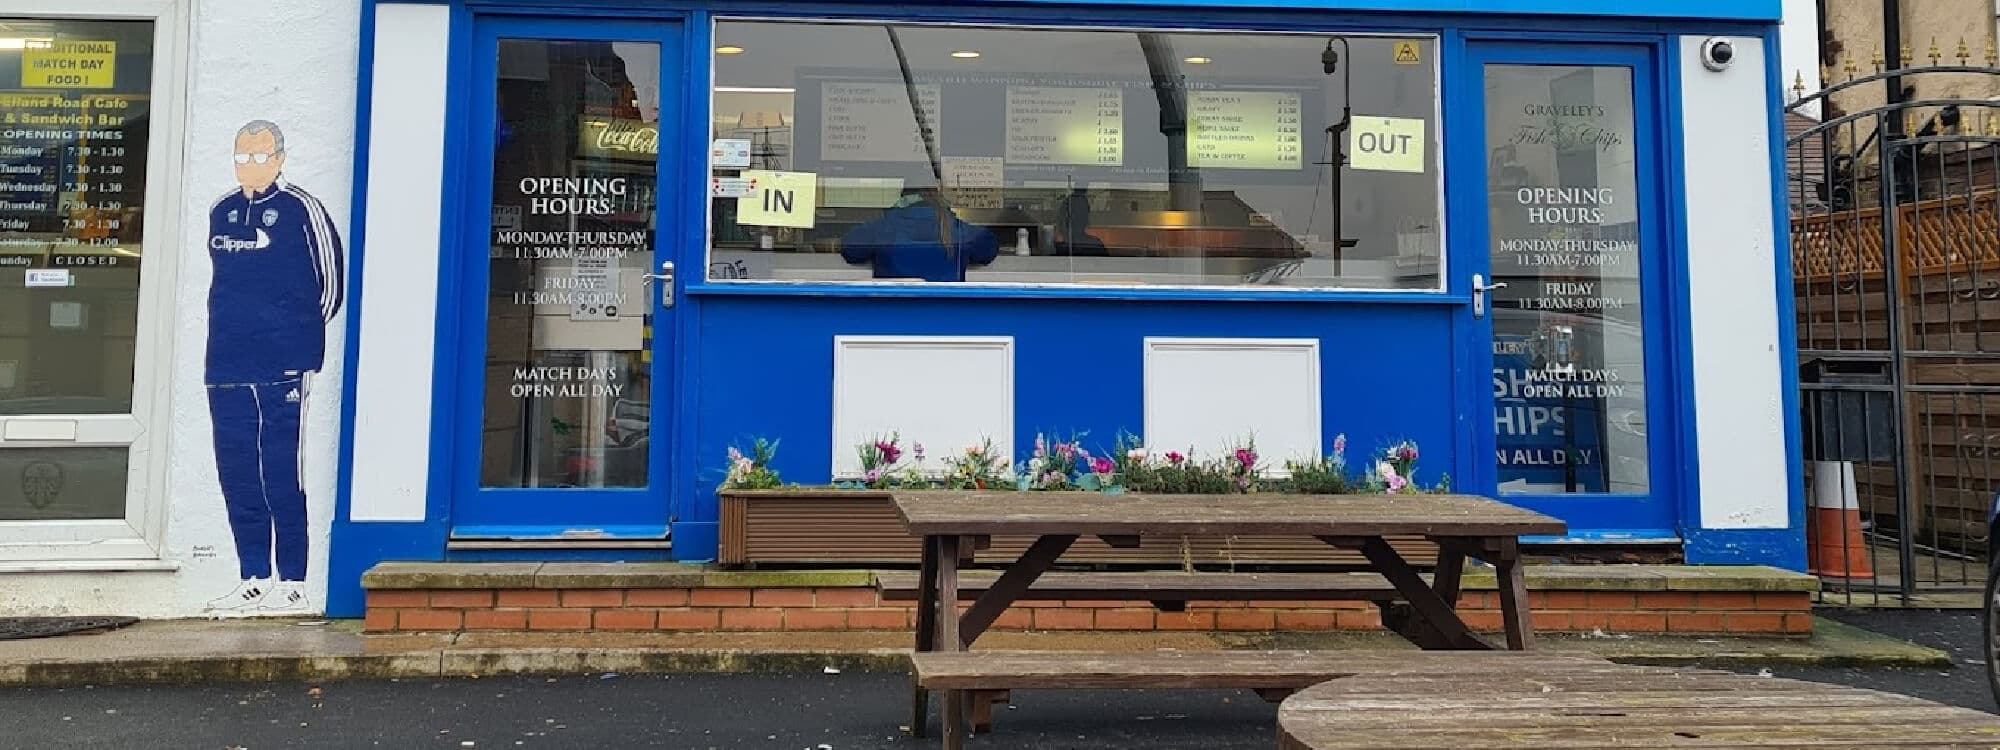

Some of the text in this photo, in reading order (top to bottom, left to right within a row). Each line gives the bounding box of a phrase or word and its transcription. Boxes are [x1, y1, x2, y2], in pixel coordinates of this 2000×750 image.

[33, 59, 104, 70] MATCH DAY
[47, 75, 81, 84] FOOD
[53, 97, 90, 109] Road
[1524, 103, 1604, 117] GRAVELEY'S
[5, 113, 125, 125] & Sandwich Bar
[3, 130, 123, 140] OPENING TIMES
[1359, 132, 1413, 155] OUT
[1, 145, 43, 157] Monday
[101, 146, 125, 157] 1.30
[0, 163, 44, 175] Tuesday
[100, 165, 124, 174] 1.30
[0, 182, 57, 194] Wednesday
[99, 182, 122, 192] 1.30
[520, 177, 626, 195] OPENING
[763, 188, 794, 214] IN
[1517, 187, 1613, 205] OPENING
[531, 198, 615, 215] HOURS:
[1528, 207, 1605, 224] HOURS:
[211, 235, 256, 252] Clipper
[497, 231, 646, 245] MONDAY-THURSDAY
[1500, 239, 1635, 251] MONDAY-THURSDAY
[514, 247, 627, 259] 11.30AM-7.00PM
[55, 256, 117, 265] CLOSED
[1517, 254, 1621, 266] 11.30AM-7.00PM
[544, 277, 597, 290] FRIDAY
[1546, 282, 1595, 295] FRIDAY
[513, 367, 617, 380] MATCH DAYS
[1525, 369, 1619, 382] MATCH DAYS
[511, 384, 624, 398] OPEN ALL DAY
[1523, 385, 1625, 398] OPEN ALL DAY
[1512, 449, 1550, 465] ALL
[1553, 449, 1592, 465] DY
